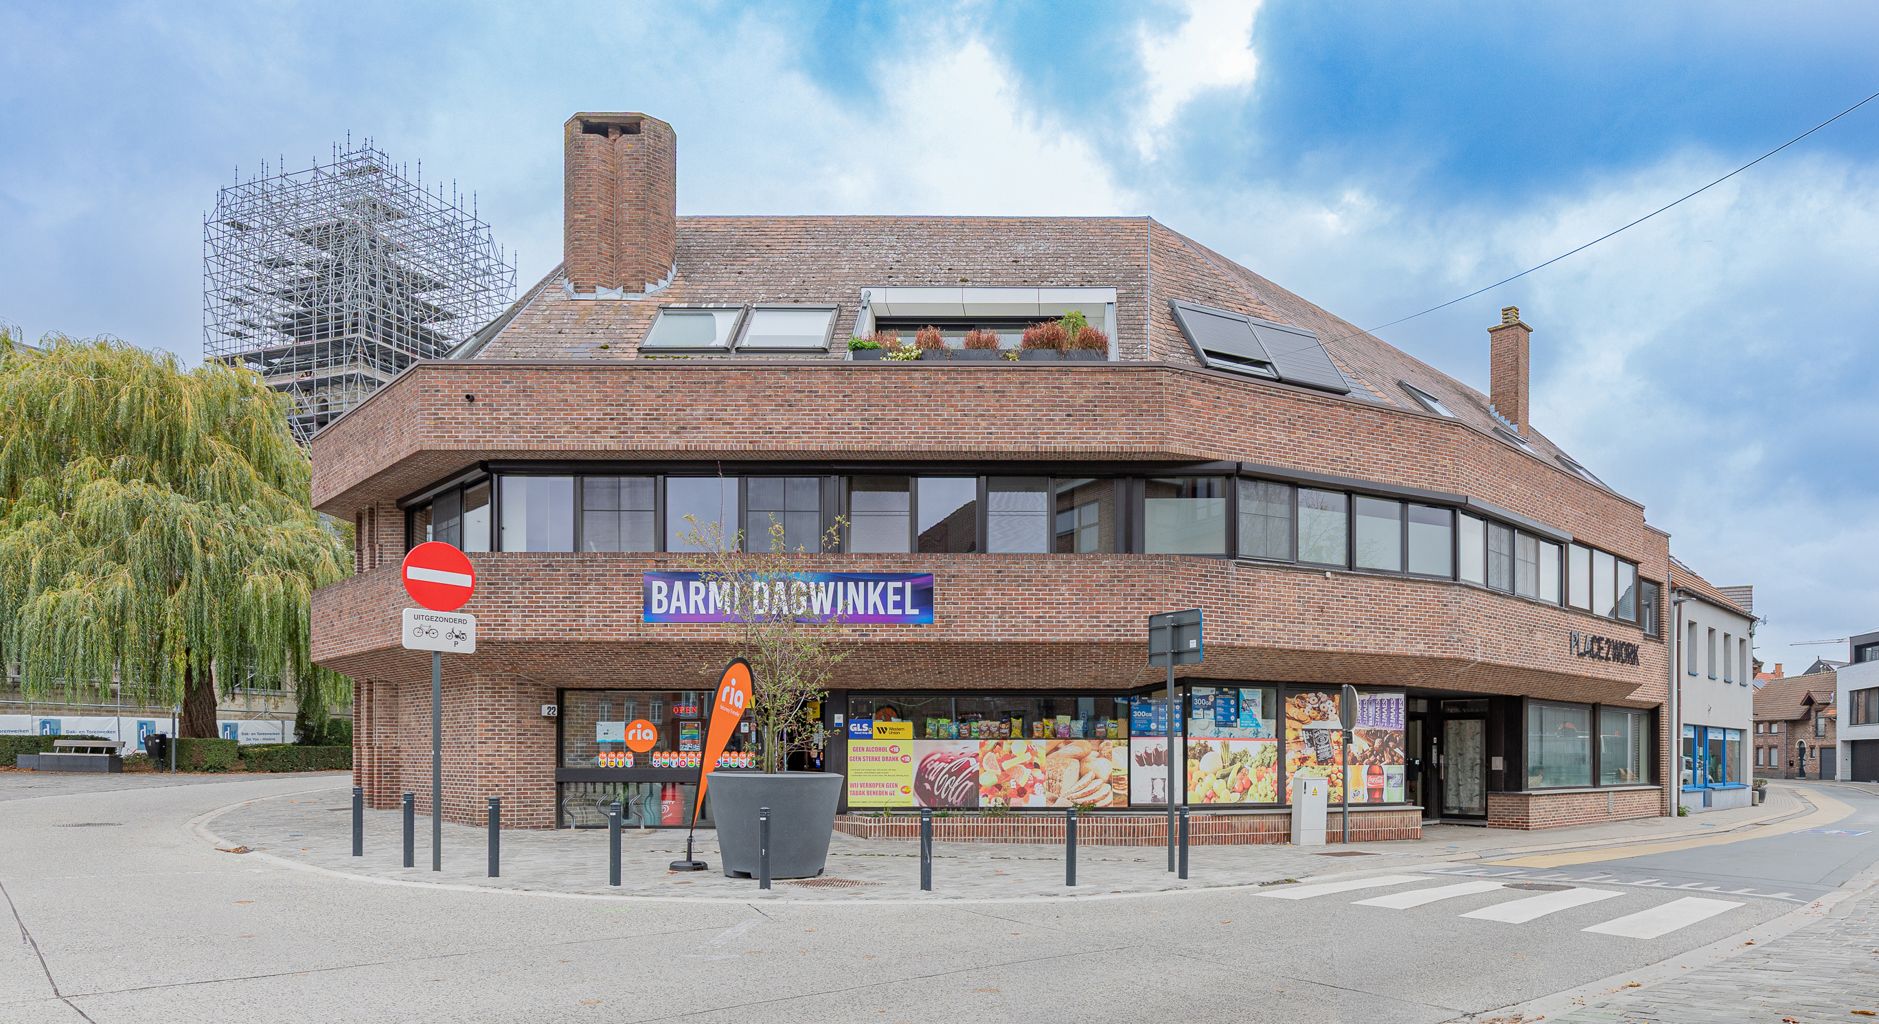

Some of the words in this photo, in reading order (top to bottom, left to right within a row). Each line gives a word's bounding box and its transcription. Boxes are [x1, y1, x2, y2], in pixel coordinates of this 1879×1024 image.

[413, 614, 468, 625] UITGEZONDERD
[1569, 629, 1640, 666] PLACE2WORK
[721, 677, 744, 709] ria
[546, 705, 556, 715] 22
[673, 706, 697, 714] OPEN
[628, 723, 653, 740] ria
[849, 723, 869, 732] GLS
